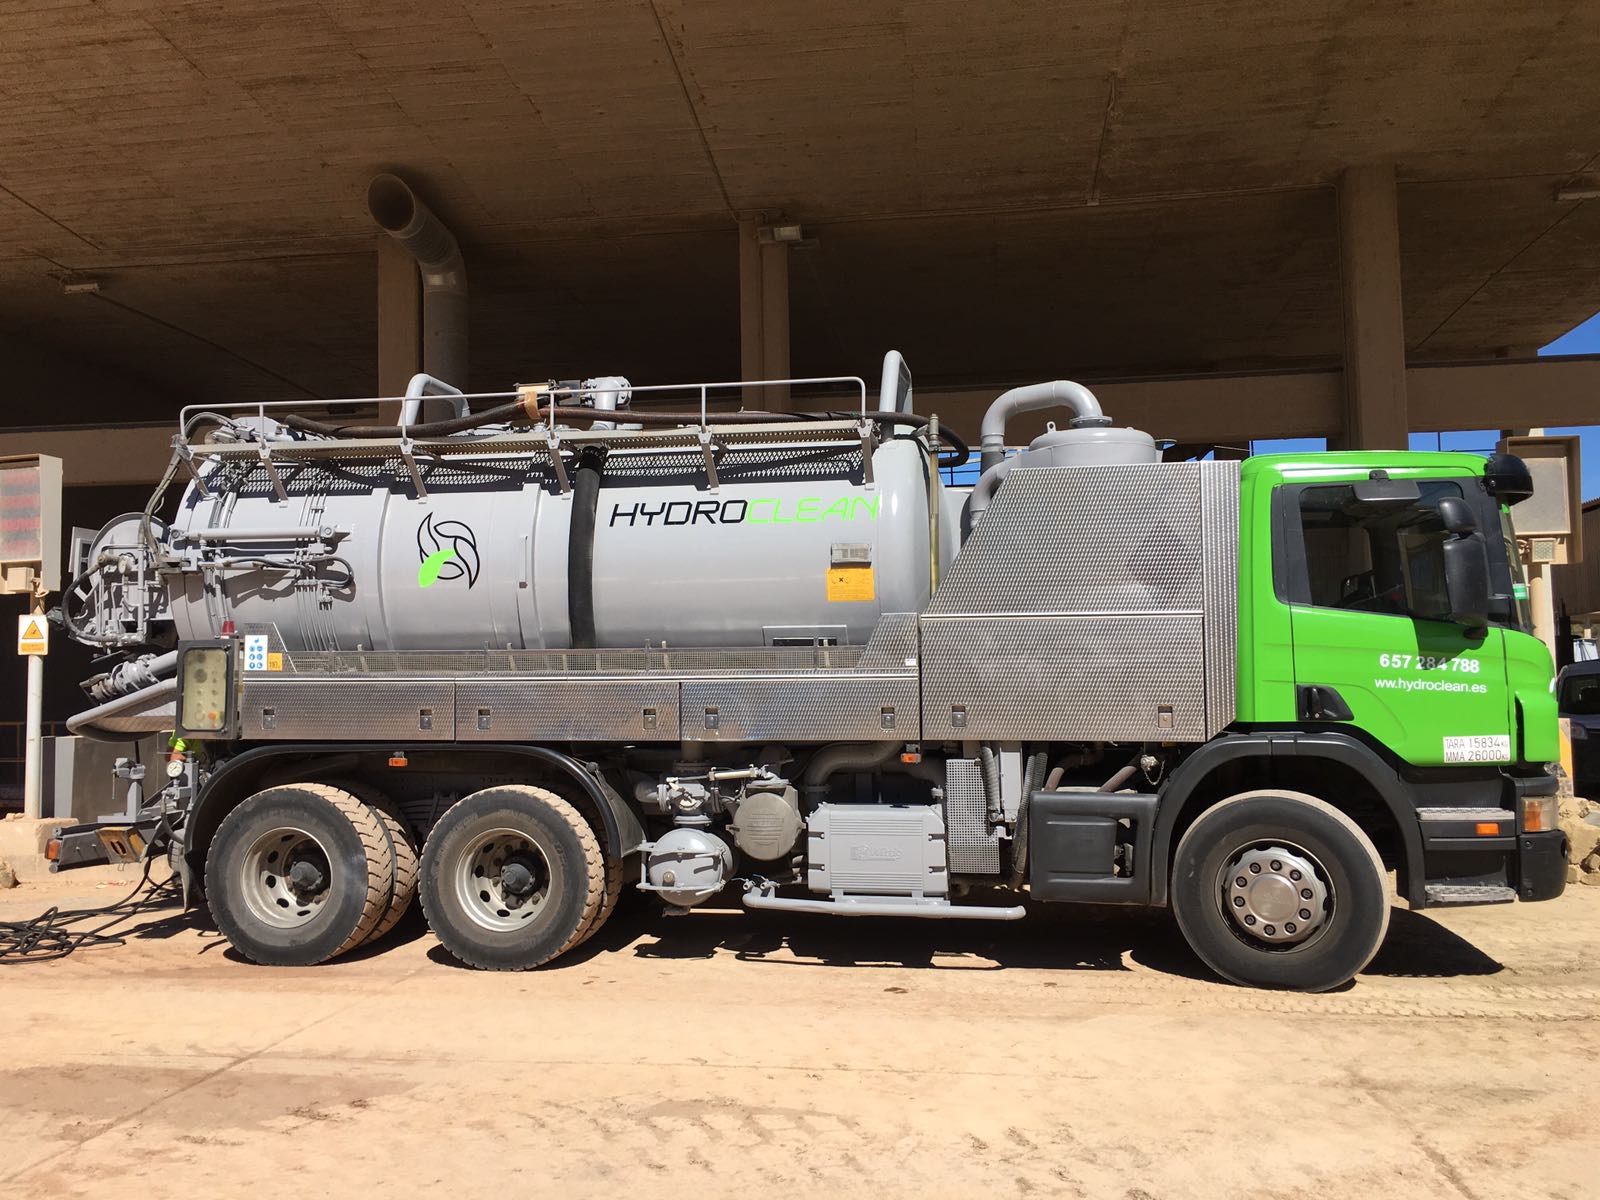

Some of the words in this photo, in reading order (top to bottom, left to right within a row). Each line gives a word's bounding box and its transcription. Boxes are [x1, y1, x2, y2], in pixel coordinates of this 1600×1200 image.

[609, 495, 880, 527] HYDROCLEAN
[1380, 653, 1412, 668] 657
[1416, 656, 1448, 671] 284
[1451, 657, 1480, 673] 788
[1445, 738, 1465, 749] TARA
[1445, 751, 1465, 762] MMA
